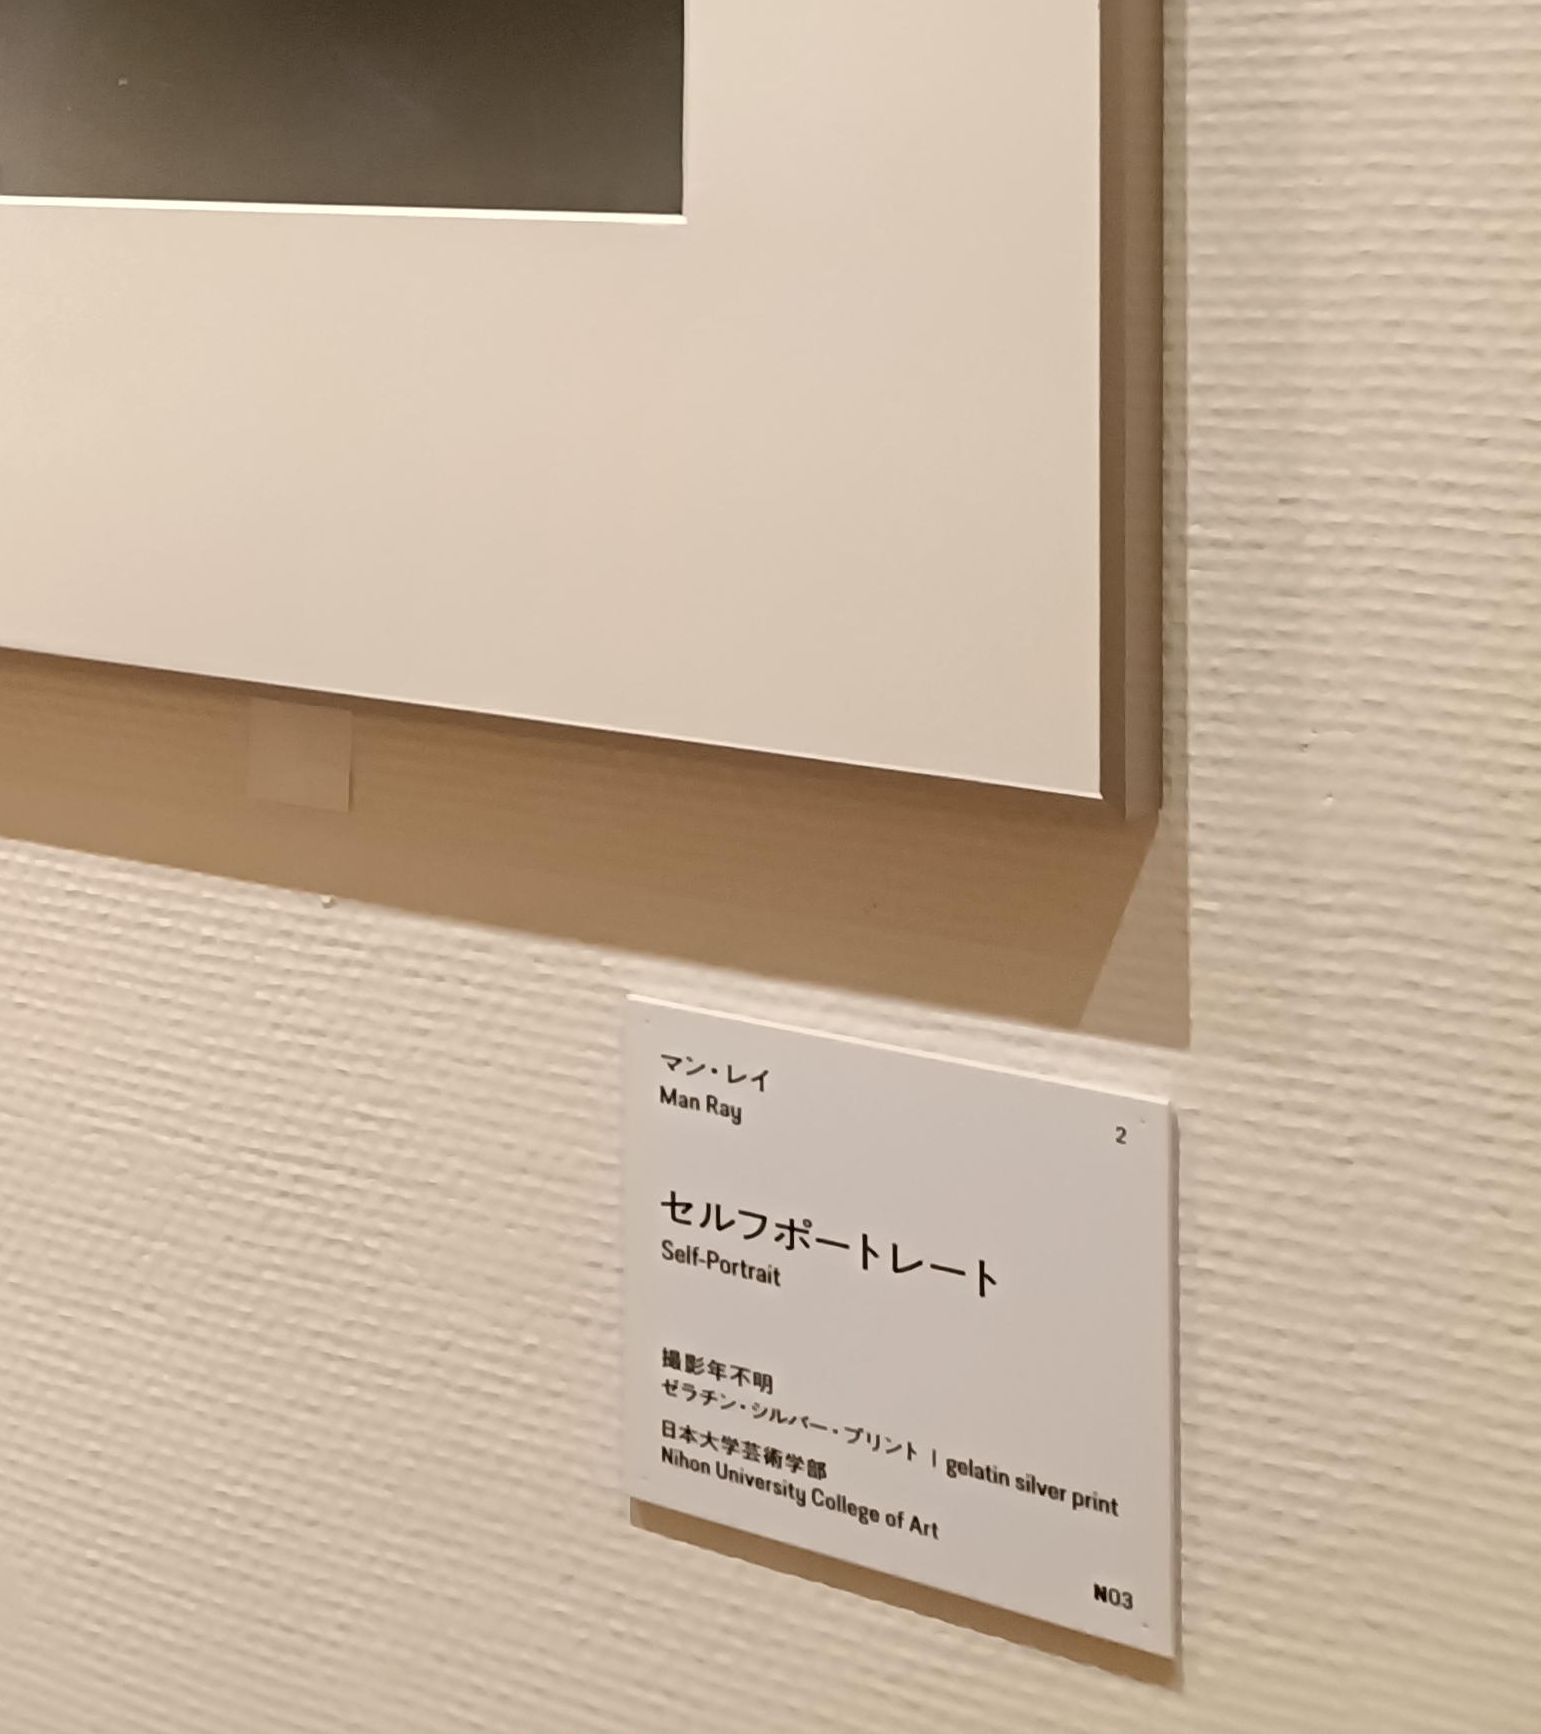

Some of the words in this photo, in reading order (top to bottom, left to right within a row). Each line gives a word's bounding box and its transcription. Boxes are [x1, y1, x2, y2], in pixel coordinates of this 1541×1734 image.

[660, 1053, 769, 1092] マン・レイ
[659, 1085, 701, 1111] Man
[705, 1094, 743, 1125] Ray
[1115, 1126, 1127, 1145] 2
[660, 1190, 997, 1298] セルフポートレート
[661, 1239, 781, 1287] Self-Portrait
[661, 1346, 774, 1395] 撮影年不明
[661, 1378, 918, 1462] ゼラチン・シルバー・プリント
[946, 1458, 1010, 1487] gelatin
[1014, 1472, 1067, 1502] silver
[1071, 1490, 1120, 1517] print
[661, 1419, 828, 1481] 日本大学芸術学部
[661, 1445, 711, 1476] Nihon
[715, 1461, 807, 1508] University
[810, 1487, 880, 1526] College
[884, 1511, 905, 1530] of
[909, 1515, 939, 1541] Art
